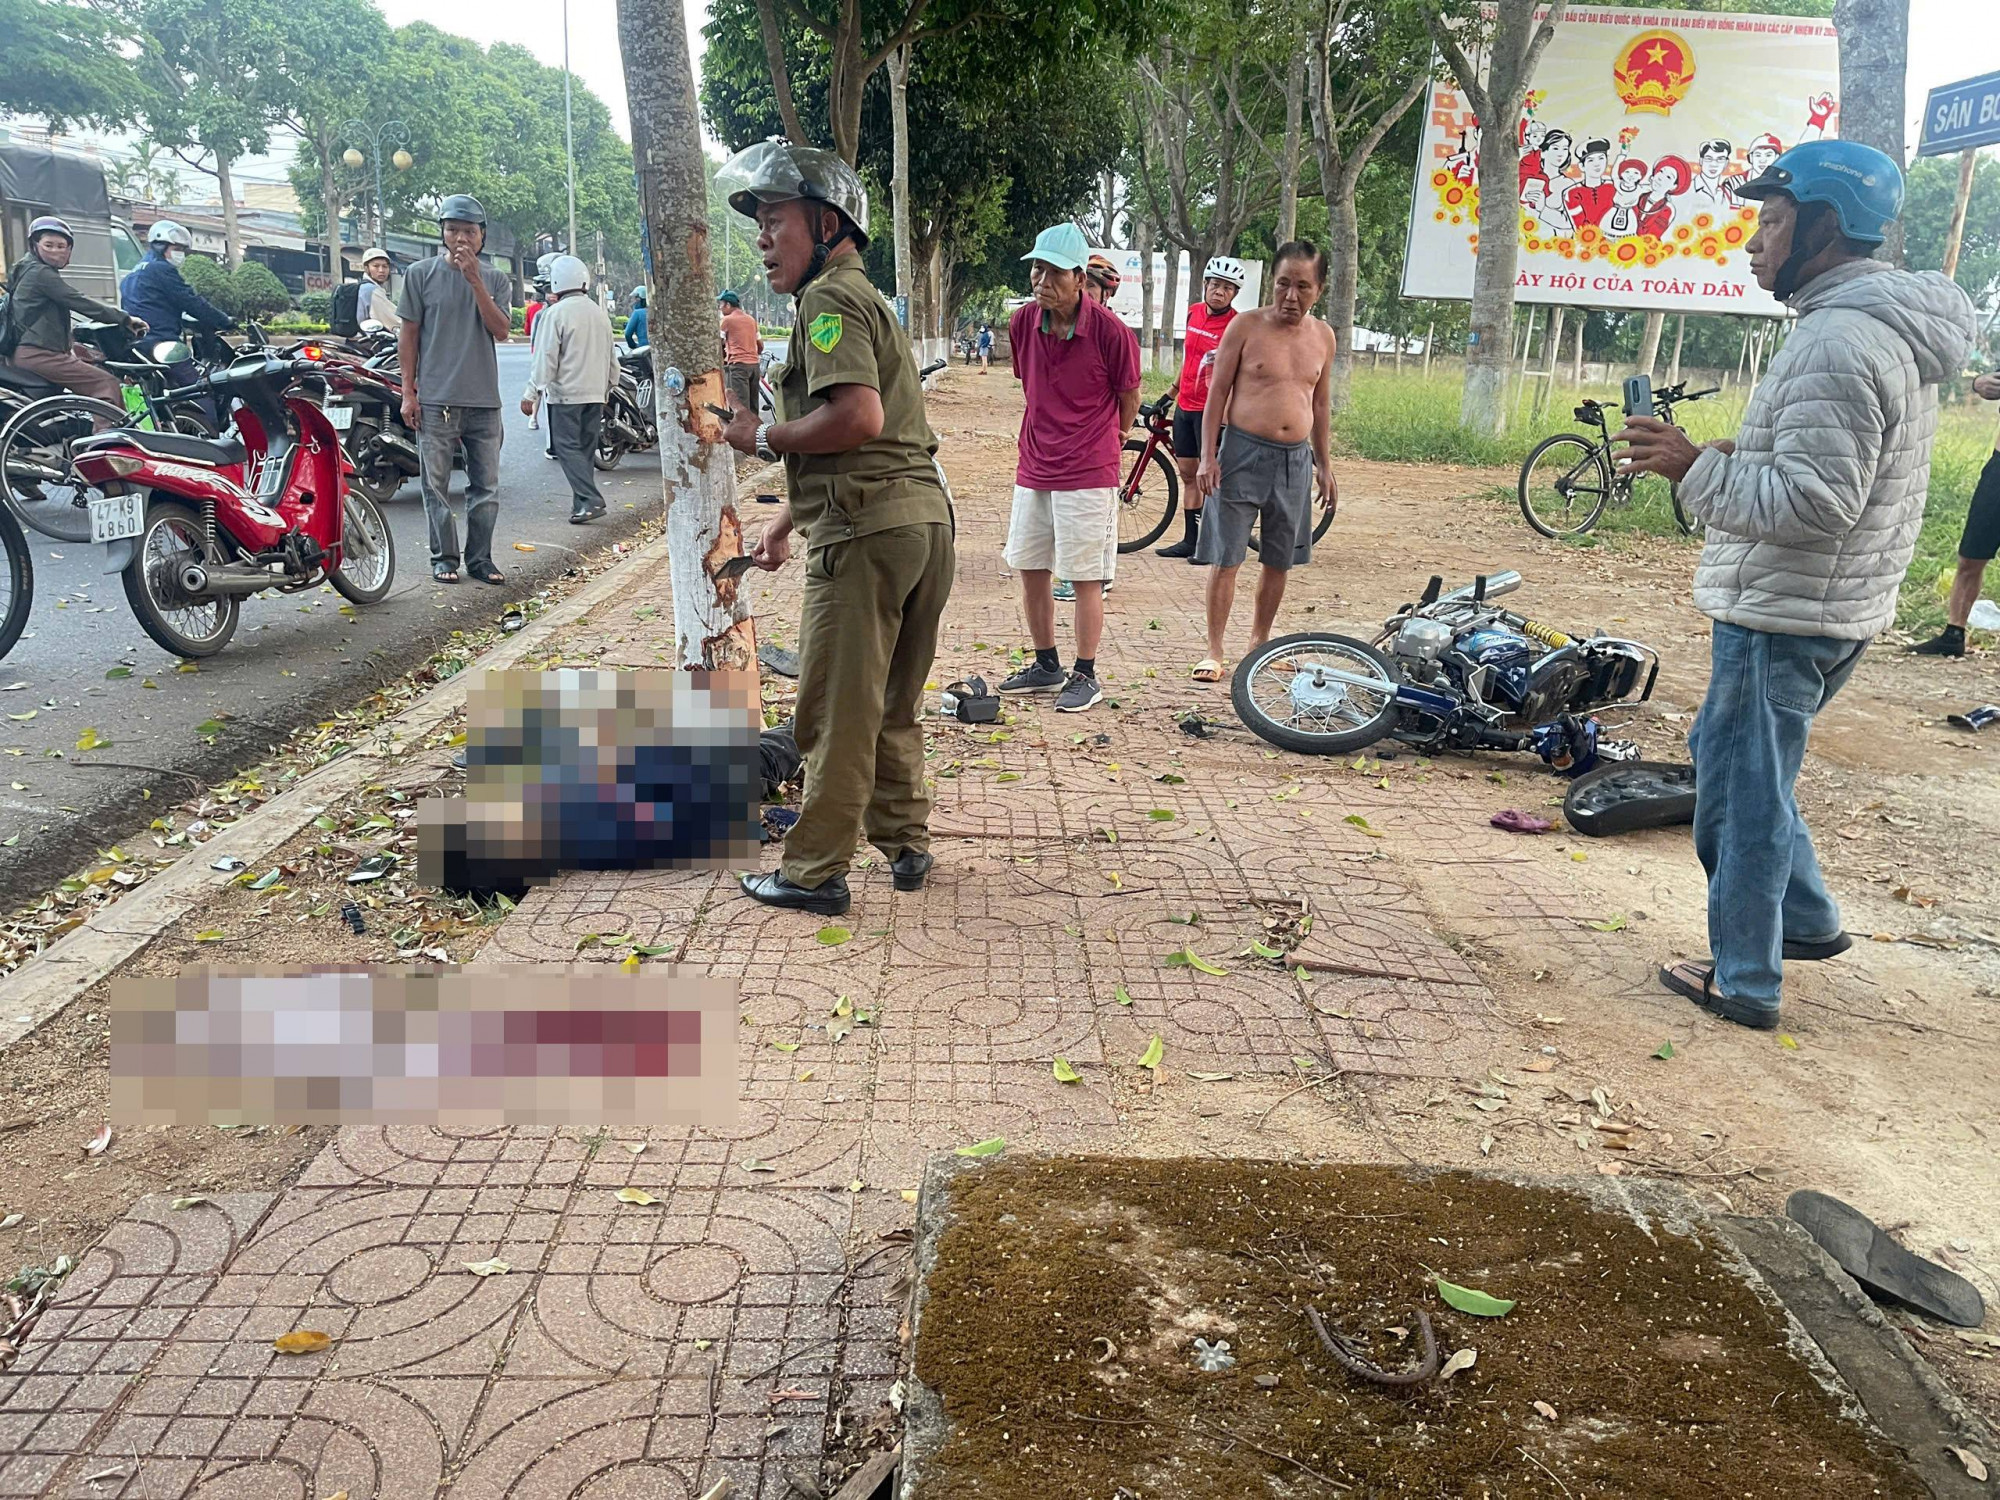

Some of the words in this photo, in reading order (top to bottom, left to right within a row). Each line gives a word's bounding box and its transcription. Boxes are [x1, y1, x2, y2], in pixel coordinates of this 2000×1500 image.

[1934, 95, 1974, 134] SÂN
[1515, 270, 1544, 287] ÀY
[1549, 272, 1586, 292] HỘI
[1593, 273, 1634, 292] CỦA
[1641, 277, 1696, 295] TOÀN
[1702, 280, 1746, 297] DÂN
[97, 498, 134, 521] 47-K9
[99, 517, 135, 539] 4860
